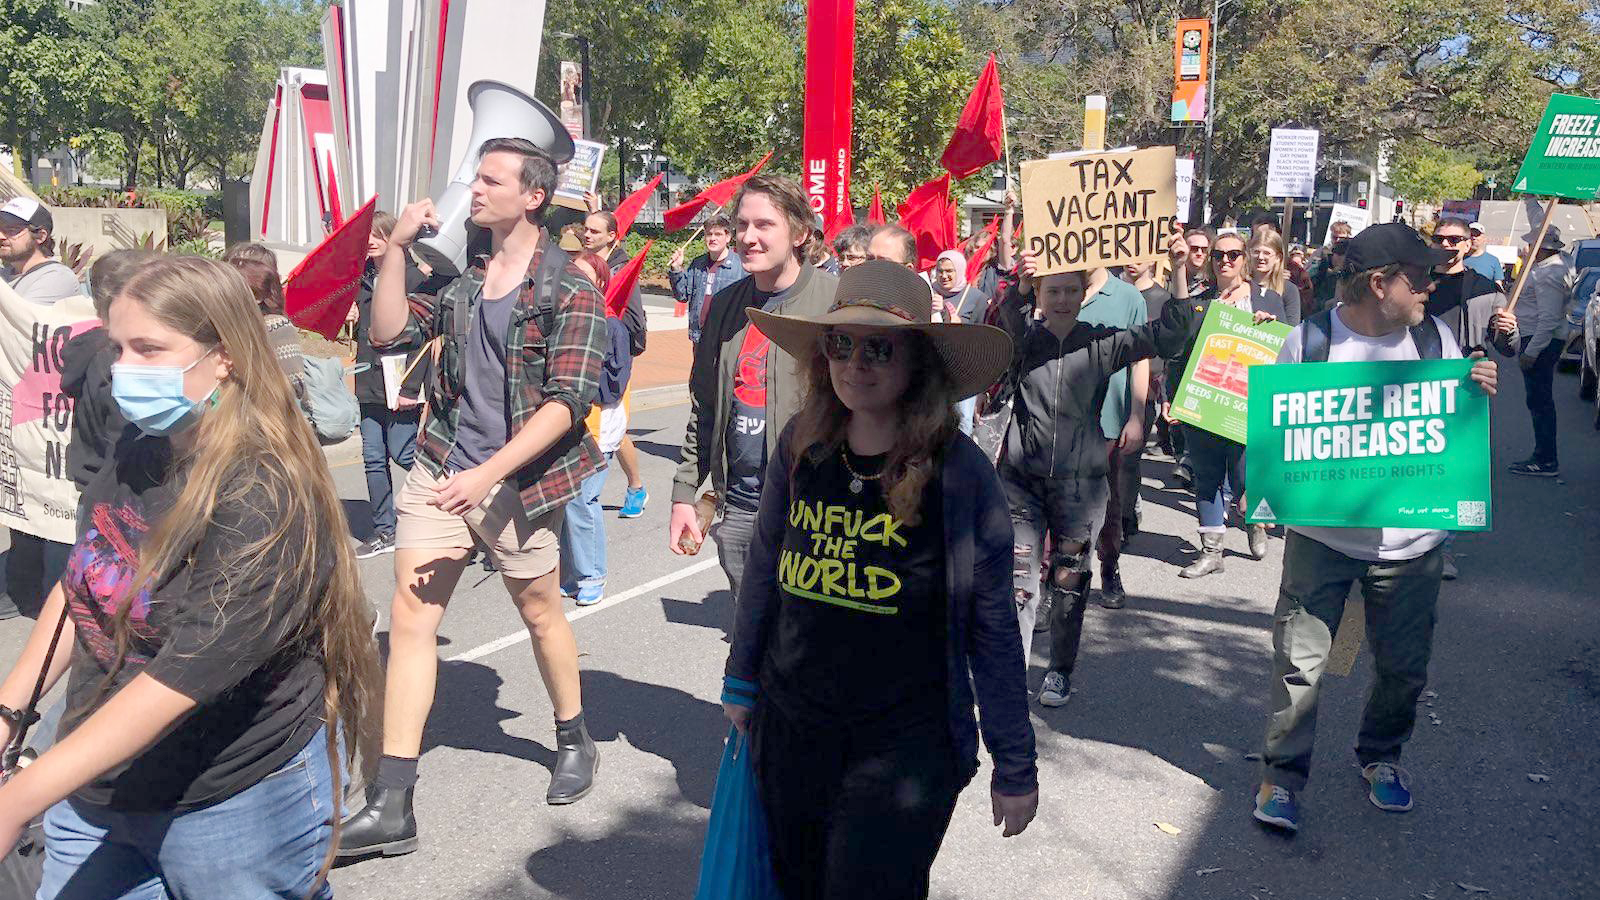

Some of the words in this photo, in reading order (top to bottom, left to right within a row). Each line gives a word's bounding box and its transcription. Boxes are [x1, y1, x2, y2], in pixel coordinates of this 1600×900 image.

[1548, 113, 1598, 136] FREEZE
[1069, 157, 1135, 193] TAX
[1046, 189, 1157, 228] VACANT
[1219, 310, 1233, 321] TELL
[1209, 337, 1234, 350] EAST
[1220, 319, 1232, 330] THE
[1232, 322, 1286, 348] GOVERNMENT
[1185, 383, 1212, 399] NEEDS
[1213, 393, 1231, 407] ITS
[1272, 386, 1373, 427] FREEZE
[1382, 379, 1460, 419] RENT
[42, 392, 70, 432] FO
[1283, 418, 1447, 462] INCREASES
[1283, 467, 1346, 485] RENTERS
[1350, 465, 1386, 481] NEED
[1391, 463, 1446, 479] RIGHTS
[789, 499, 908, 548] UNFUCK
[1399, 506, 1415, 515] Find
[810, 533, 858, 559] THE
[778, 549, 902, 600] WORLD
